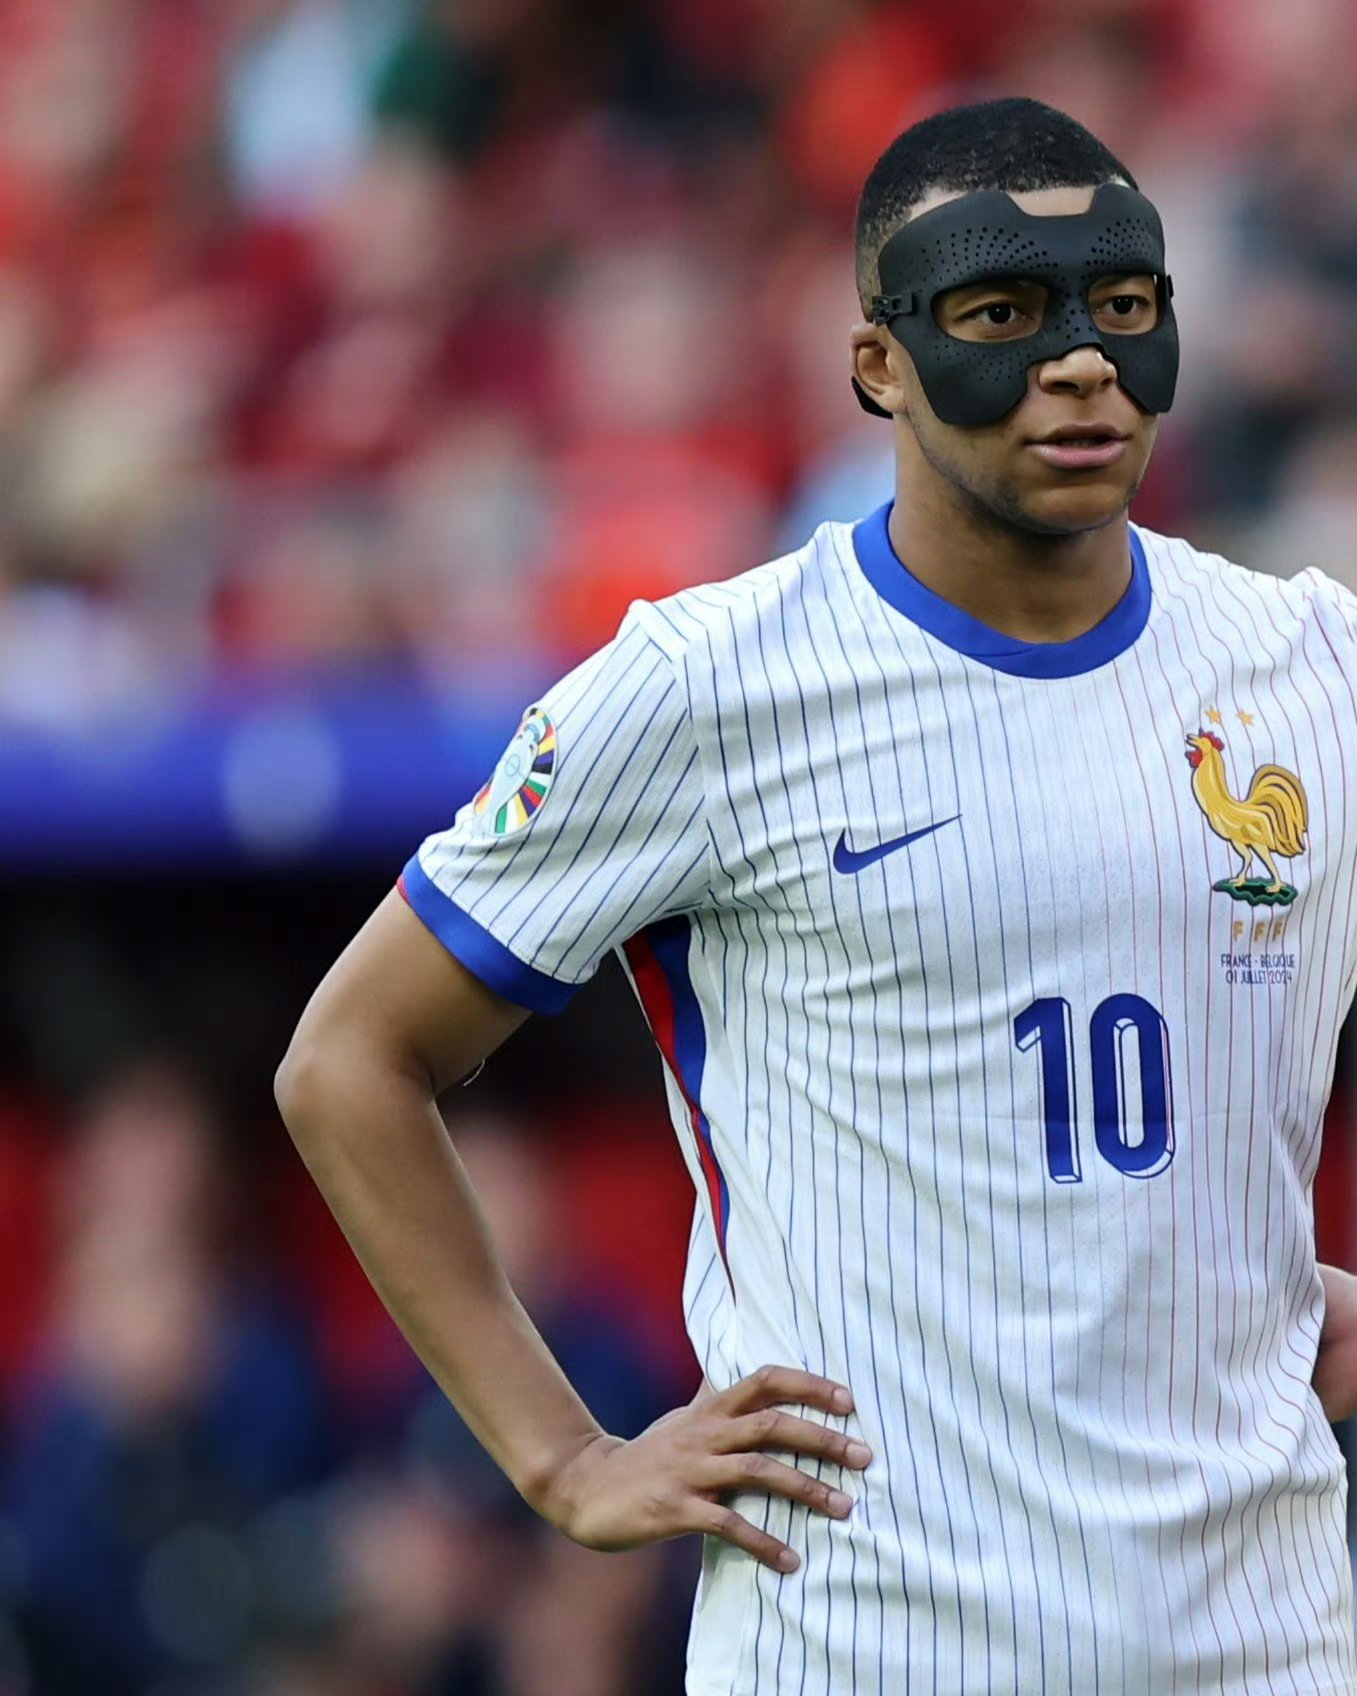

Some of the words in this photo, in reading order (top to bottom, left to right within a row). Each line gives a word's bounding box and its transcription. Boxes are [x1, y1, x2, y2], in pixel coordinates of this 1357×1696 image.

[1220, 953, 1251, 967] FRANCE
[1260, 954, 1295, 968] BELGIQUE
[1225, 969, 1237, 984] 01
[1013, 993, 1177, 1184] 10
